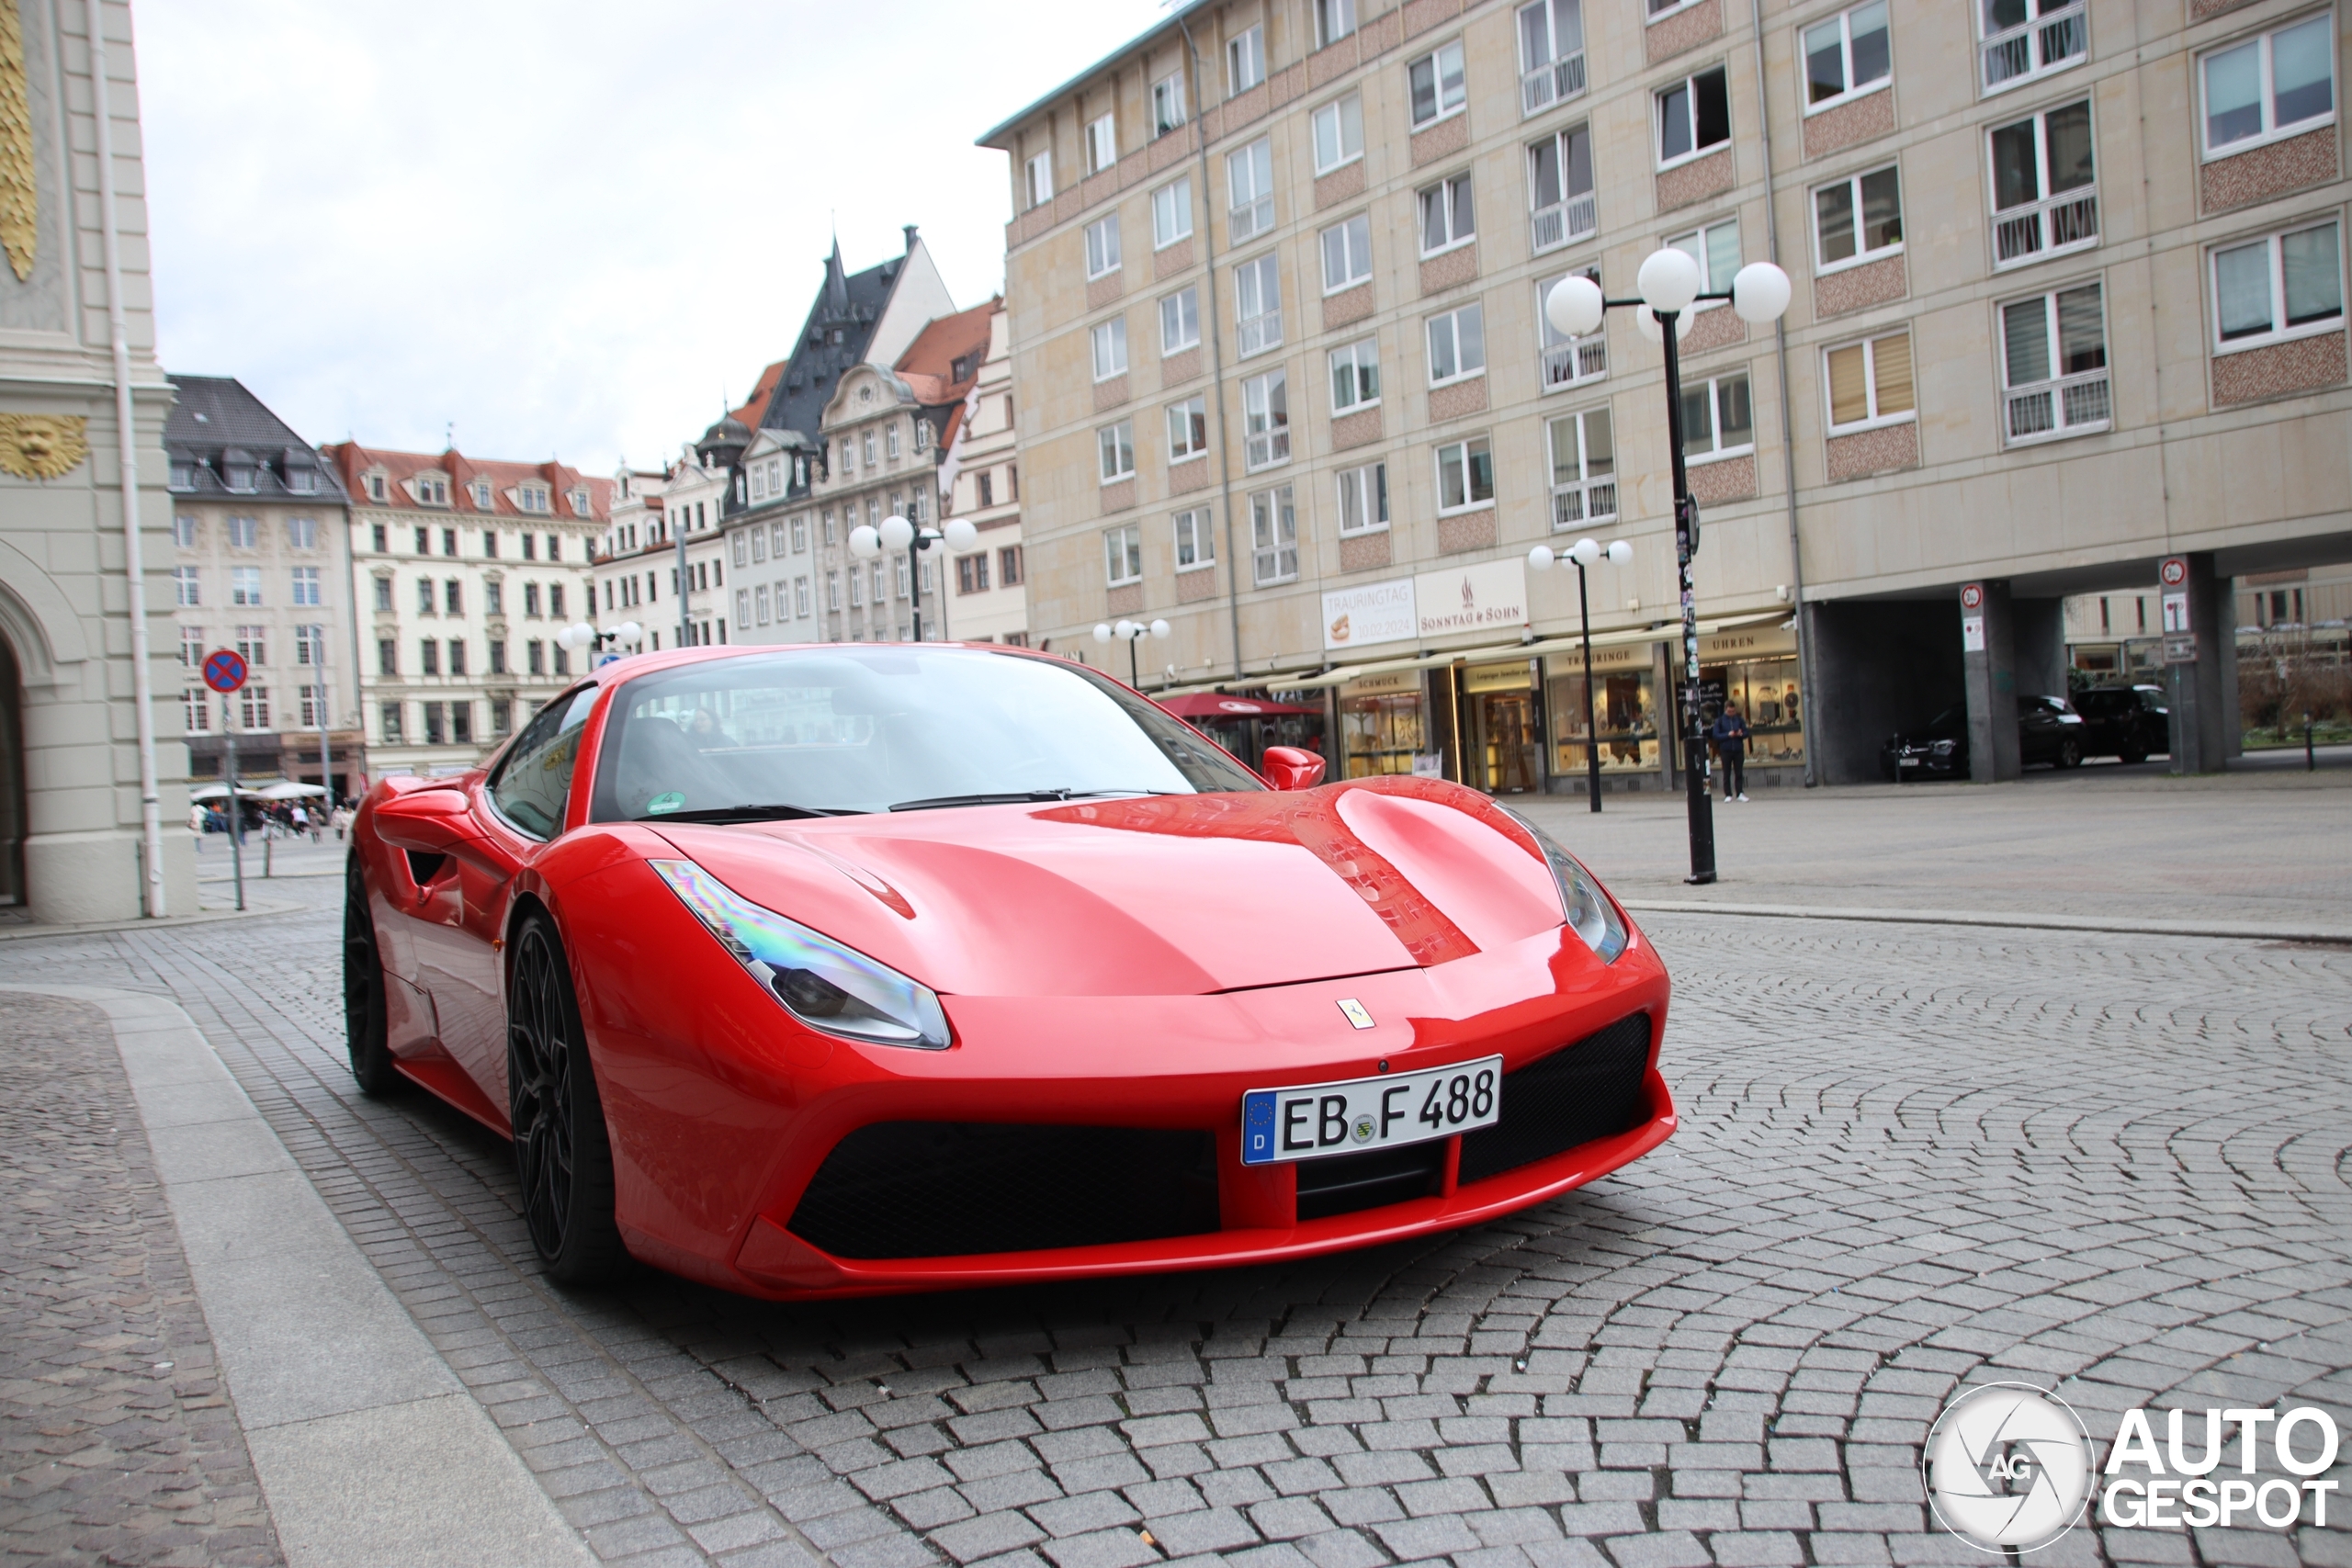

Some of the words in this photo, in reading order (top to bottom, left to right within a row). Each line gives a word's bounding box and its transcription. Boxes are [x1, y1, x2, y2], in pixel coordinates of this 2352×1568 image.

[1328, 586, 1408, 612] TRAURINGTAG
[1420, 612, 1473, 631] SONNTAG
[1486, 605, 1520, 621] SOHN
[1358, 618, 1410, 639] 10.02.2024
[1713, 636, 1756, 650] UHREN
[1358, 675, 1399, 689] SCHMUCK
[662, 792, 673, 803] 4
[1283, 1093, 1348, 1151] EB
[1380, 1085, 1410, 1138] F
[1419, 1069, 1495, 1129] 488
[1254, 1134, 1265, 1150] D
